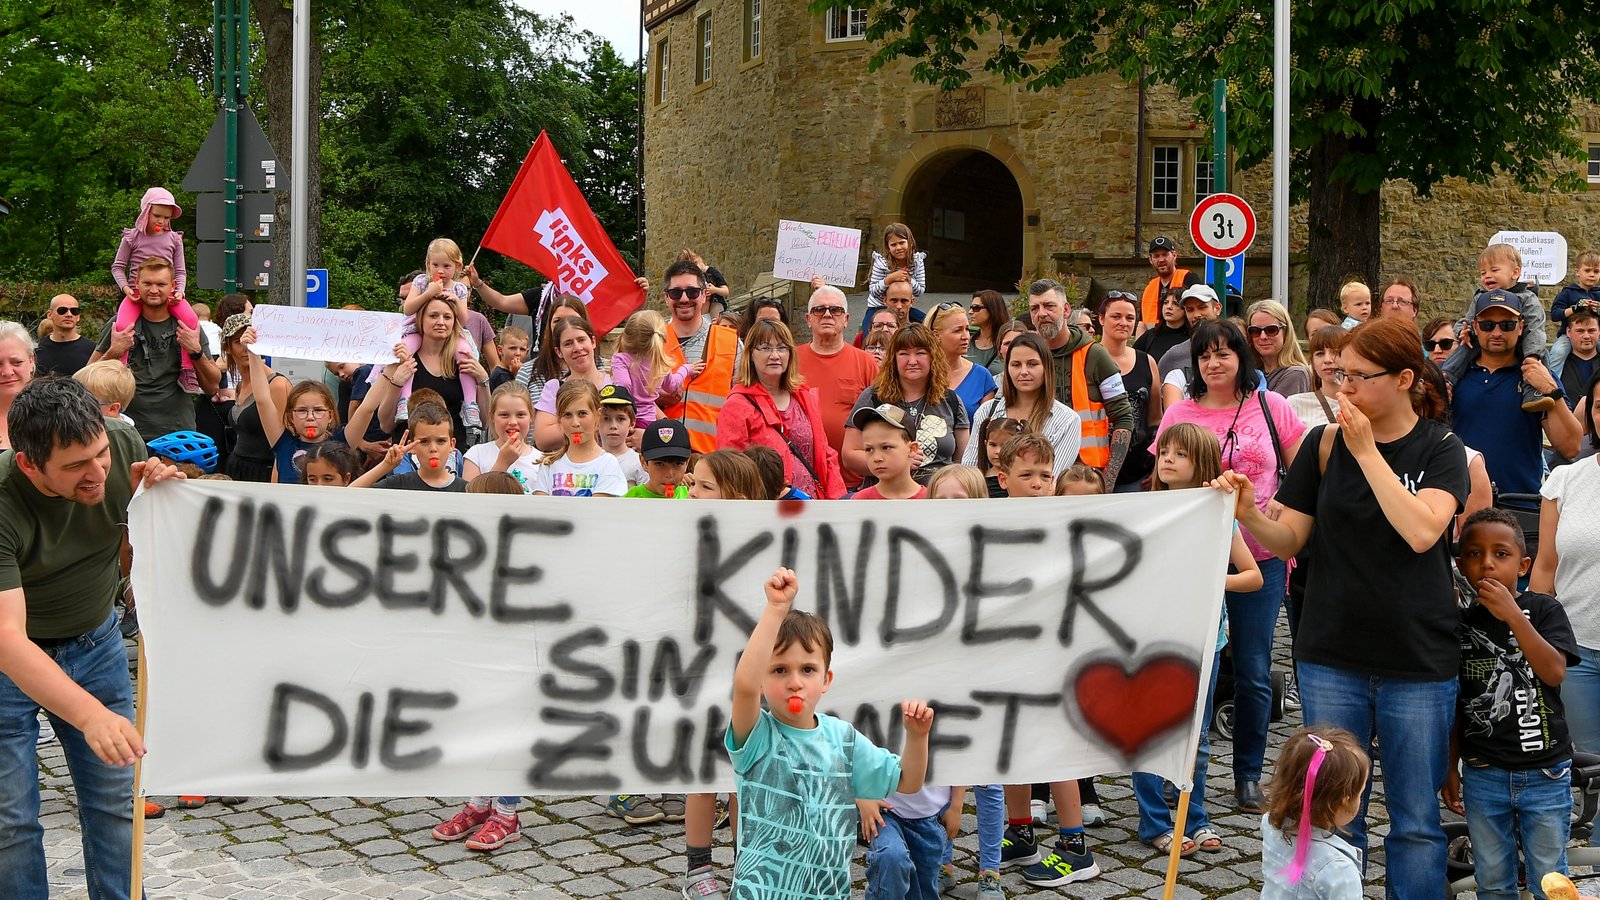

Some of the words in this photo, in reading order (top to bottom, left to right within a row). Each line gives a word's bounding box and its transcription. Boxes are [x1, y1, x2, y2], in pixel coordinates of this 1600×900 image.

[549, 218, 594, 275] links
[1212, 213, 1234, 239] 3t
[1501, 235, 1519, 243] Leere
[1520, 235, 1555, 244] Stadtkasse
[1531, 260, 1552, 268] Kosten
[191, 496, 574, 622] UNSERE
[540, 627, 755, 708] SIN
[263, 683, 459, 772] DIE
[528, 690, 1061, 791] ZUKNFT
